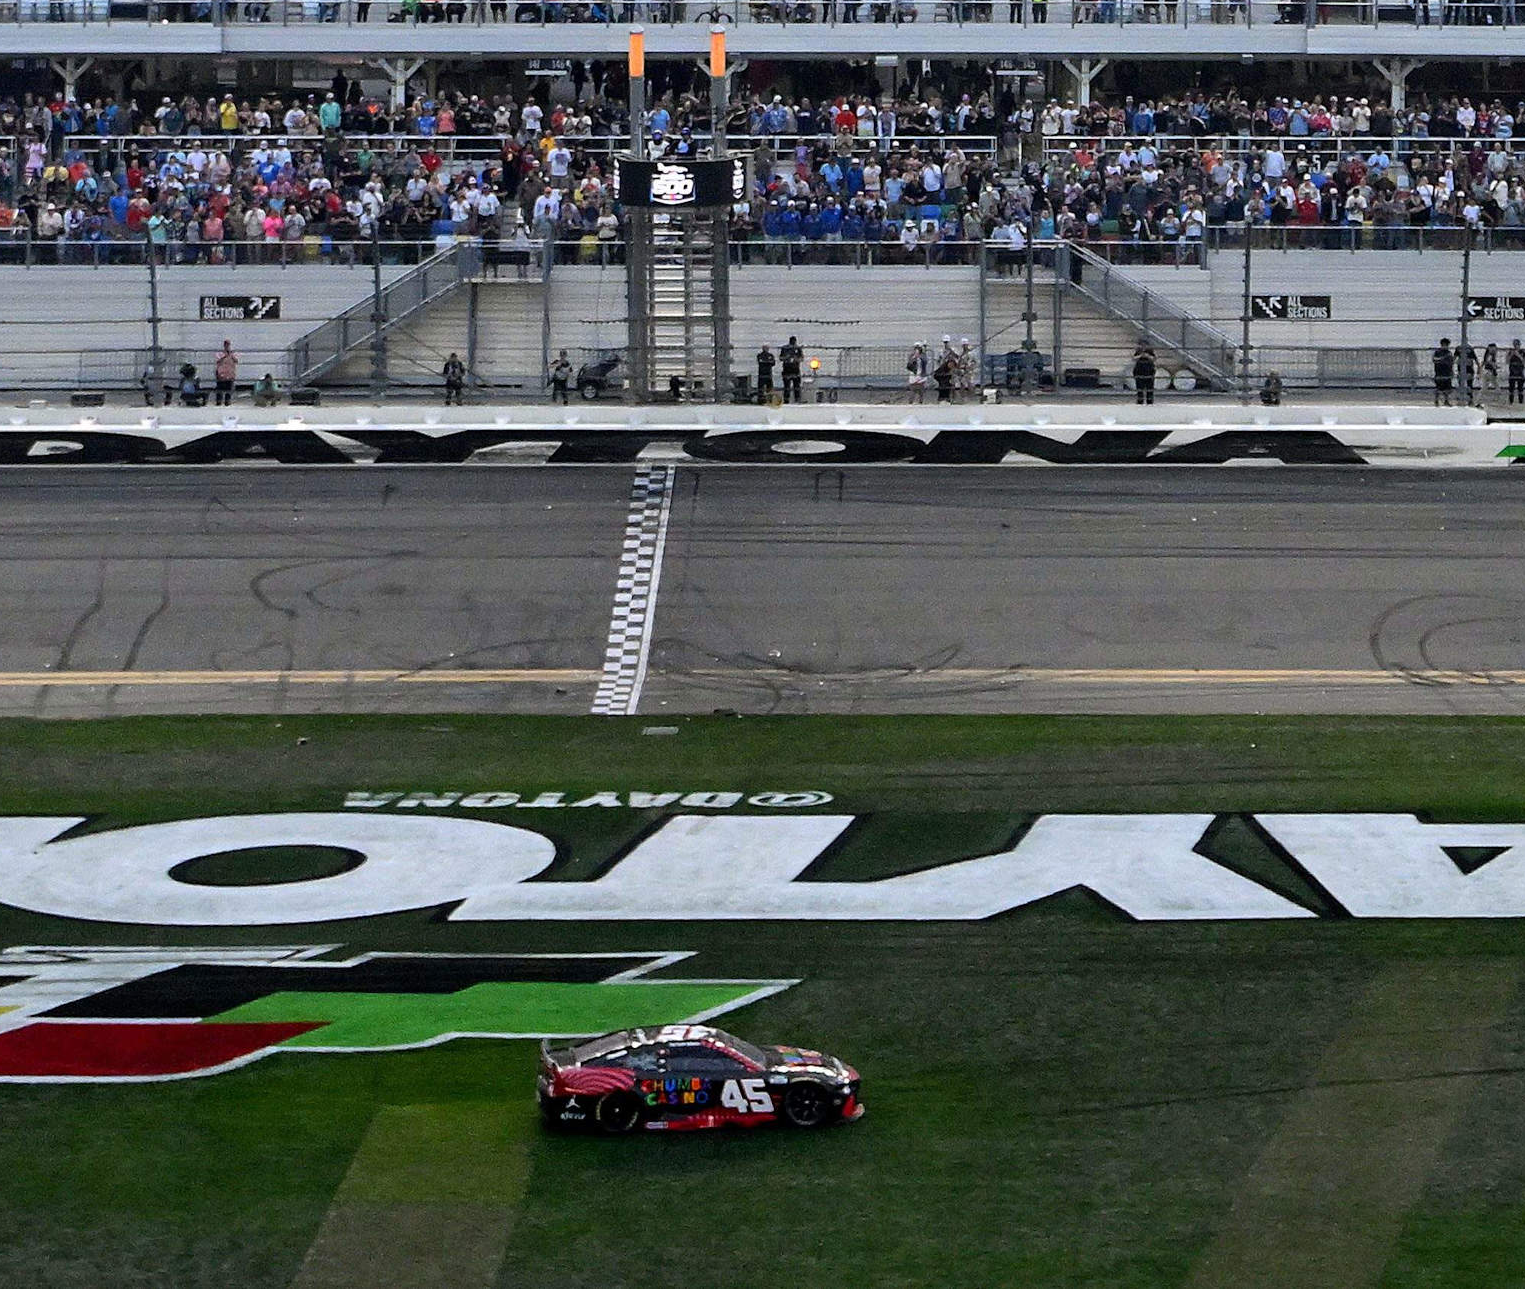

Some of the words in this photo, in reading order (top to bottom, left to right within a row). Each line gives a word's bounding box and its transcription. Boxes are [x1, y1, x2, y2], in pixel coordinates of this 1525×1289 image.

[203, 297, 219, 307] ALL
[1287, 296, 1302, 307] ALL
[1495, 297, 1512, 308] ALL
[203, 307, 245, 319] SECTIONS
[1286, 307, 1329, 318] SECTIONS
[1483, 308, 1525, 319] SECTIONS
[343, 790, 834, 809] @DAYTONA
[721, 1078, 775, 1113] 45
